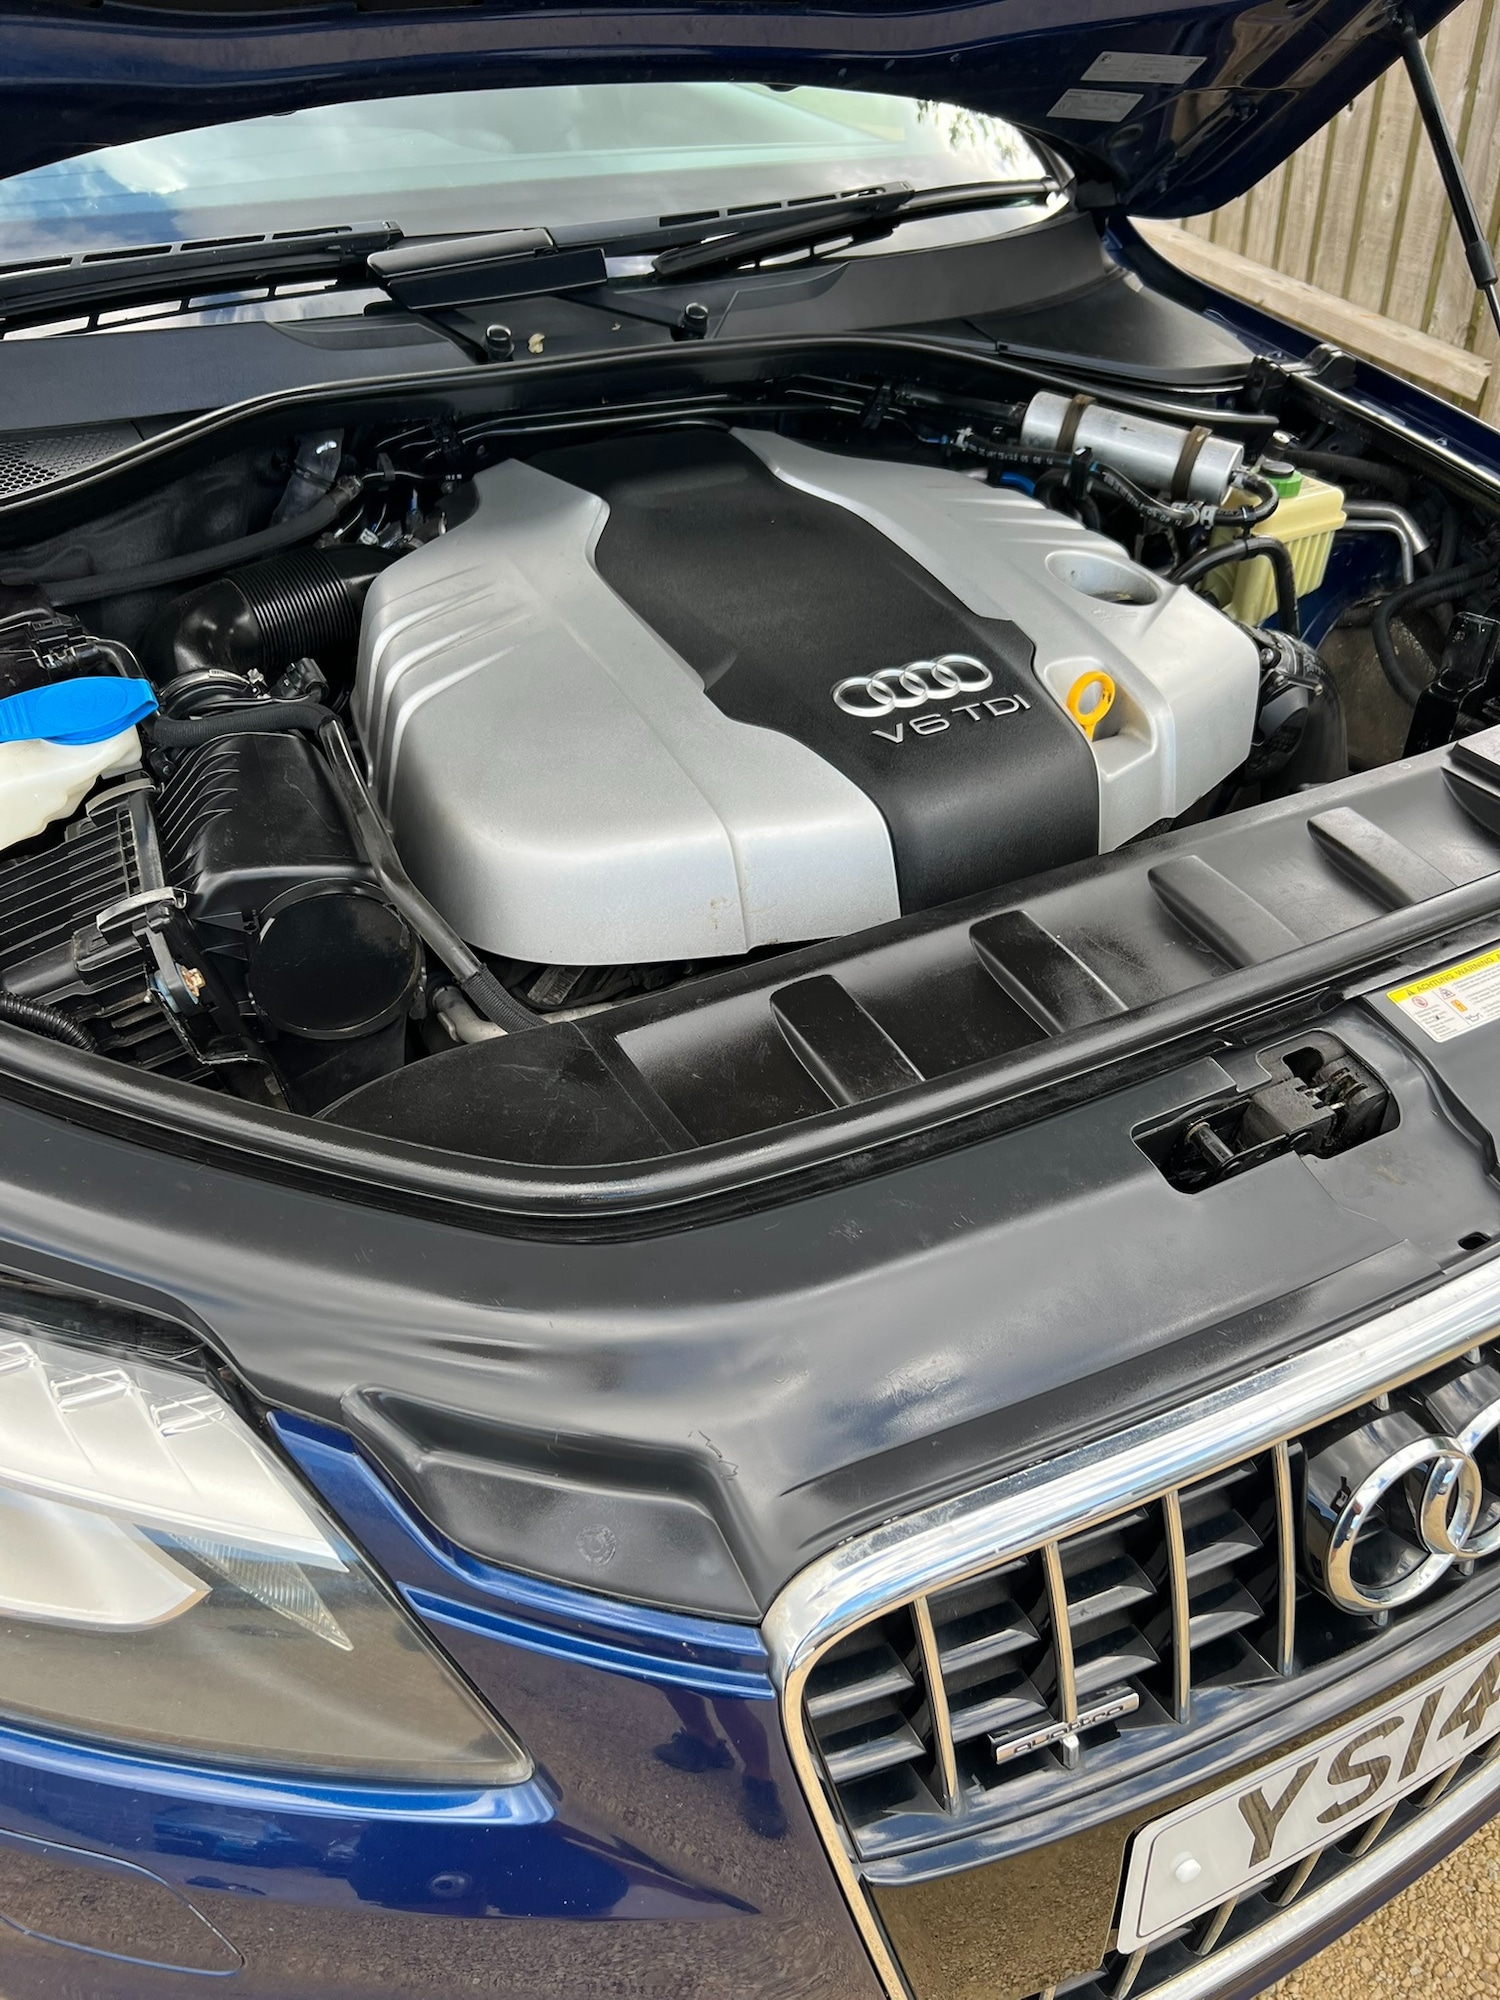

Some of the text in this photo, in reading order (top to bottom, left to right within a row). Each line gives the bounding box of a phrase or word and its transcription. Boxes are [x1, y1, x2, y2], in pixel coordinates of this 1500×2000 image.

[872, 694, 1031, 744] V6 TDI
[1416, 974, 1455, 992] ACHTUNG
[1455, 957, 1494, 976] WARNING
[1014, 1705, 1124, 1754] quattro
[1238, 1651, 1500, 1869] YS14
